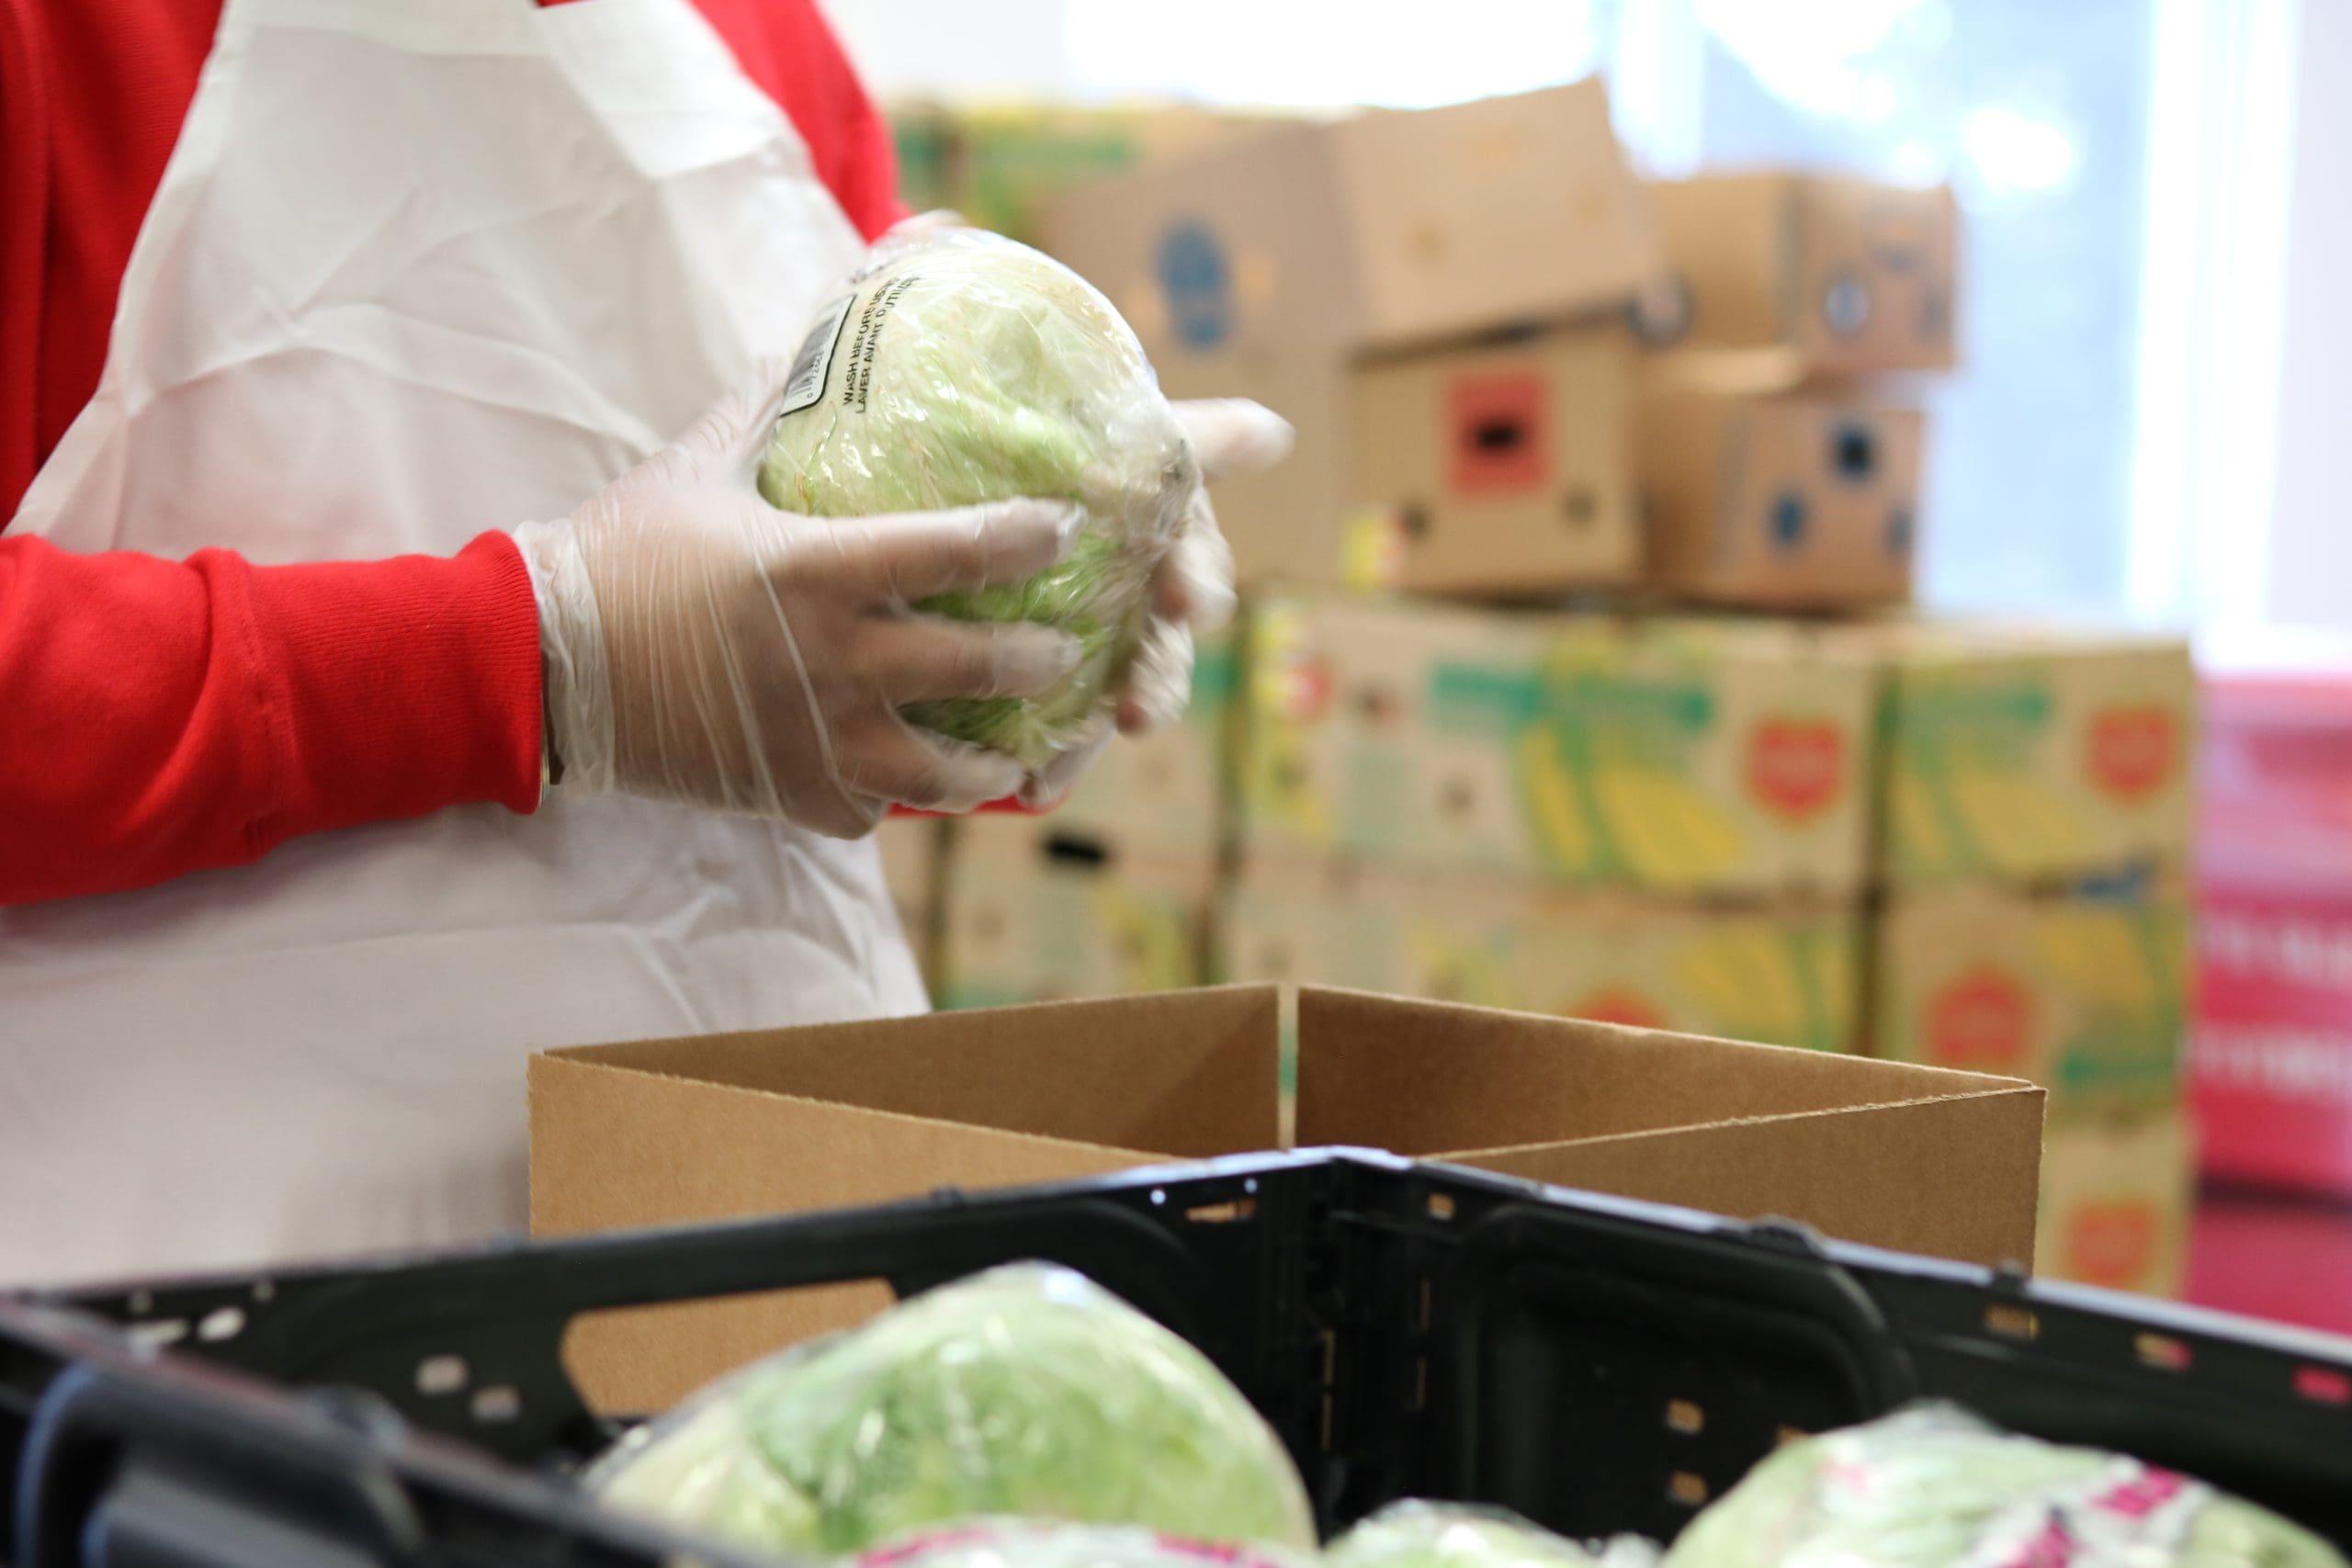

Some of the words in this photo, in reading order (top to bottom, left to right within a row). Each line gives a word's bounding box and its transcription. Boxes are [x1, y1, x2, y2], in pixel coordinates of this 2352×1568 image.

[850, 307, 876, 359] BEFORE
[842, 362, 859, 405] WASH
[855, 367, 872, 413] LAVER
[864, 322, 884, 363] AVANT
